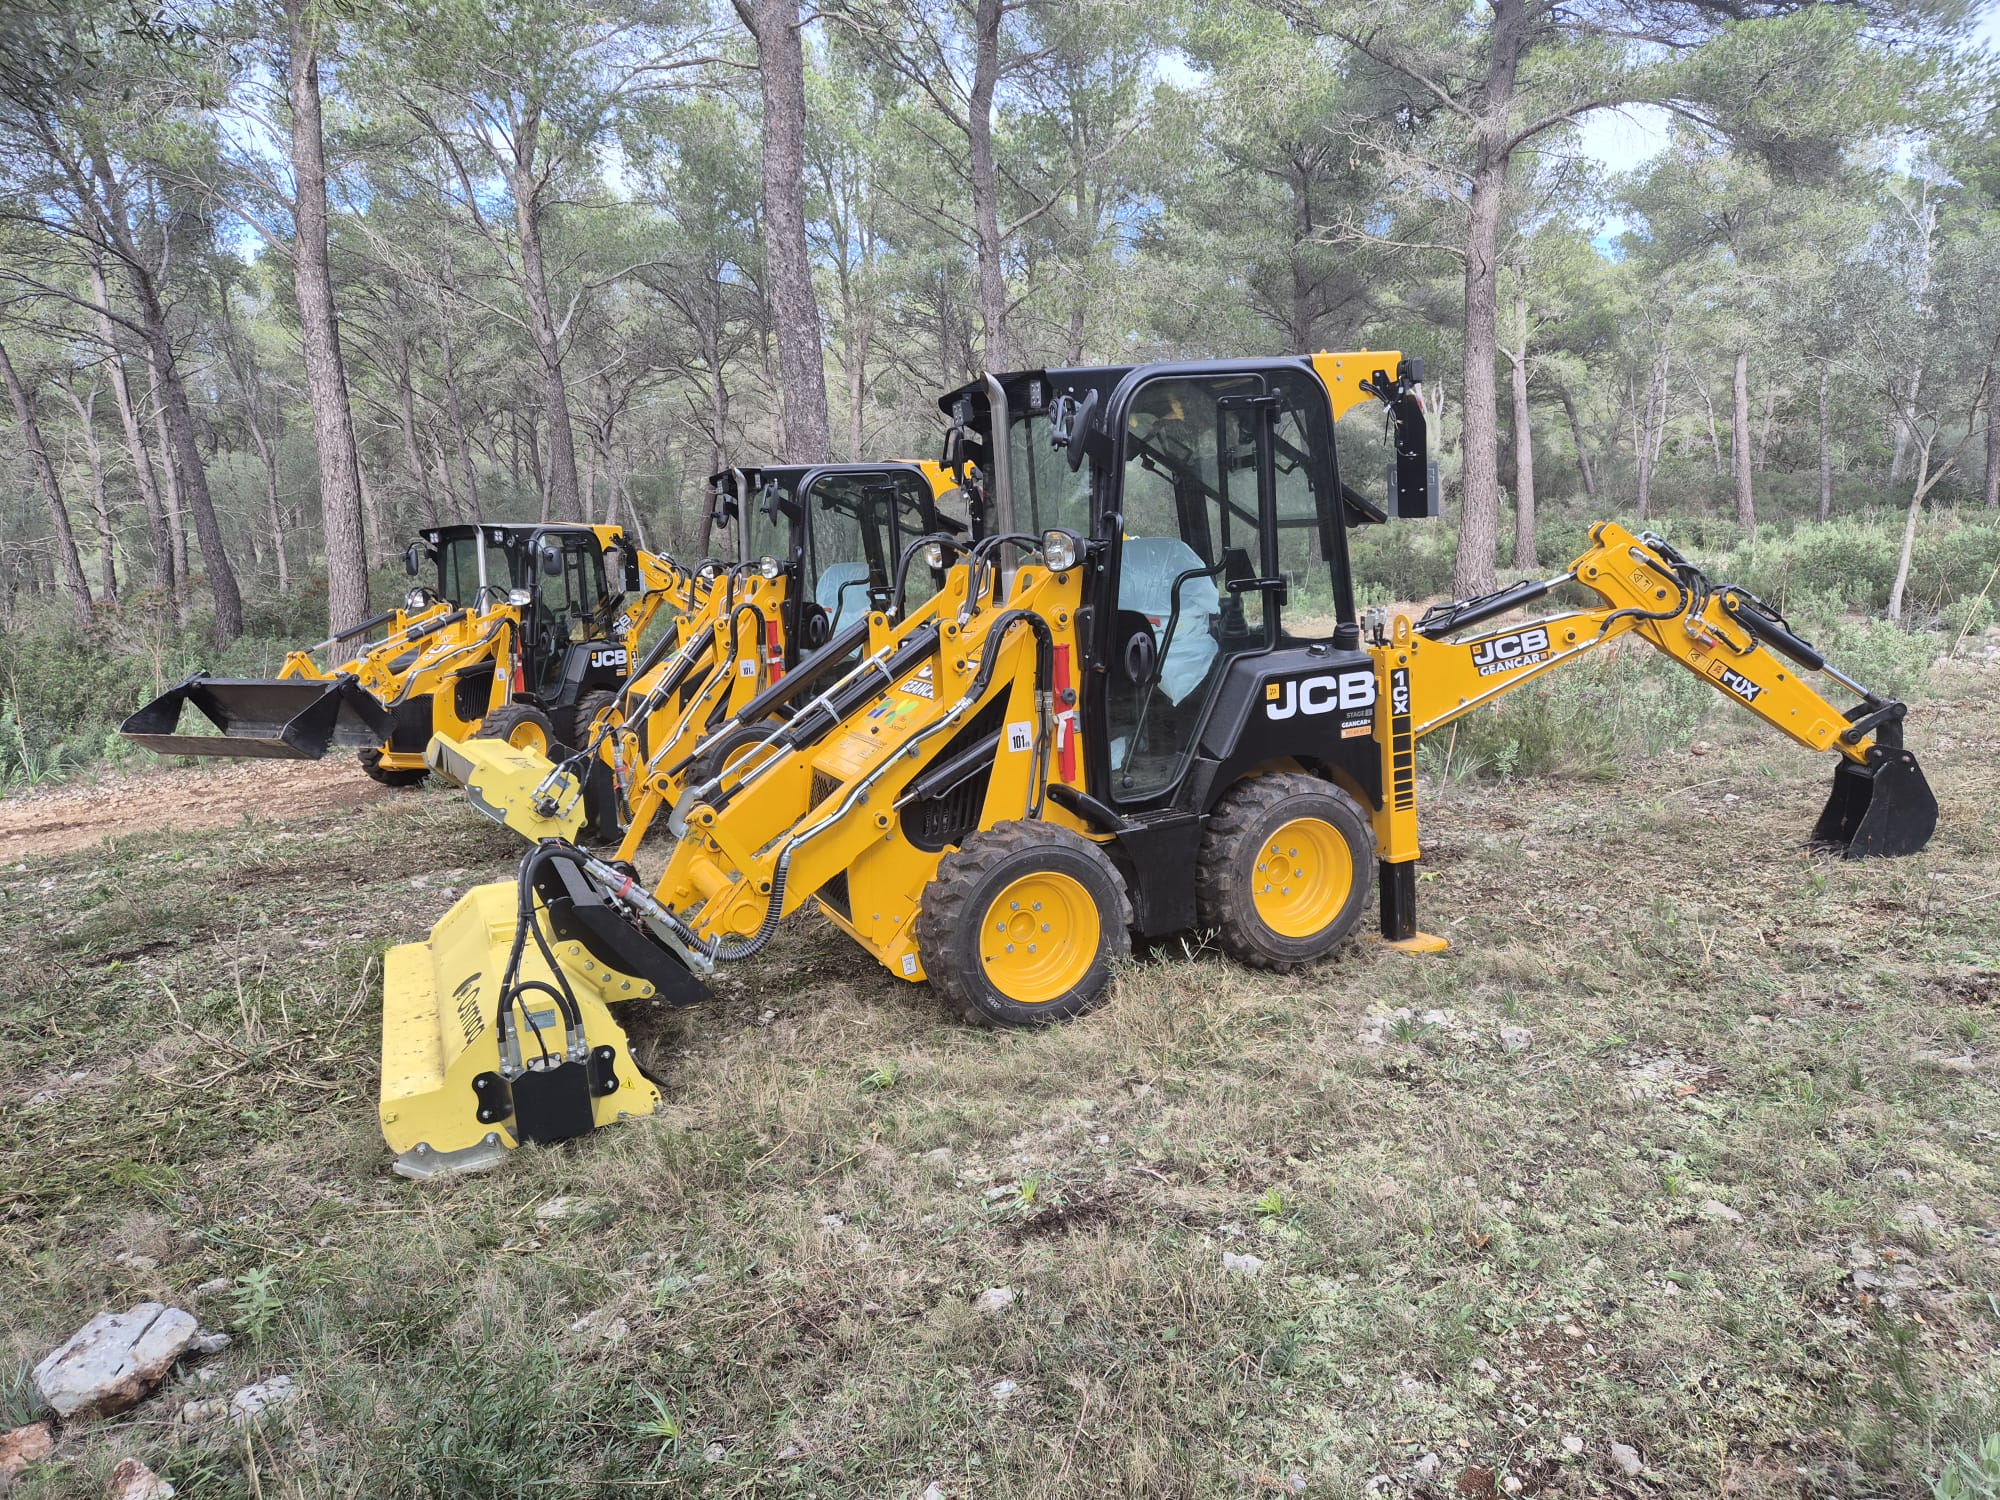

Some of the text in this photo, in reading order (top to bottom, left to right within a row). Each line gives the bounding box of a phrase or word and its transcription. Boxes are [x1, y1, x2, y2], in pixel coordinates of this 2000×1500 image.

[591, 650, 627, 668] JCB
[1474, 629, 1548, 665] JCB
[1480, 653, 1540, 676] GEANCAR
[1266, 671, 1376, 720] JCB
[1393, 670, 1409, 715] 1CX
[1012, 734, 1025, 749] 101
[457, 987, 485, 1053] Osmaq
